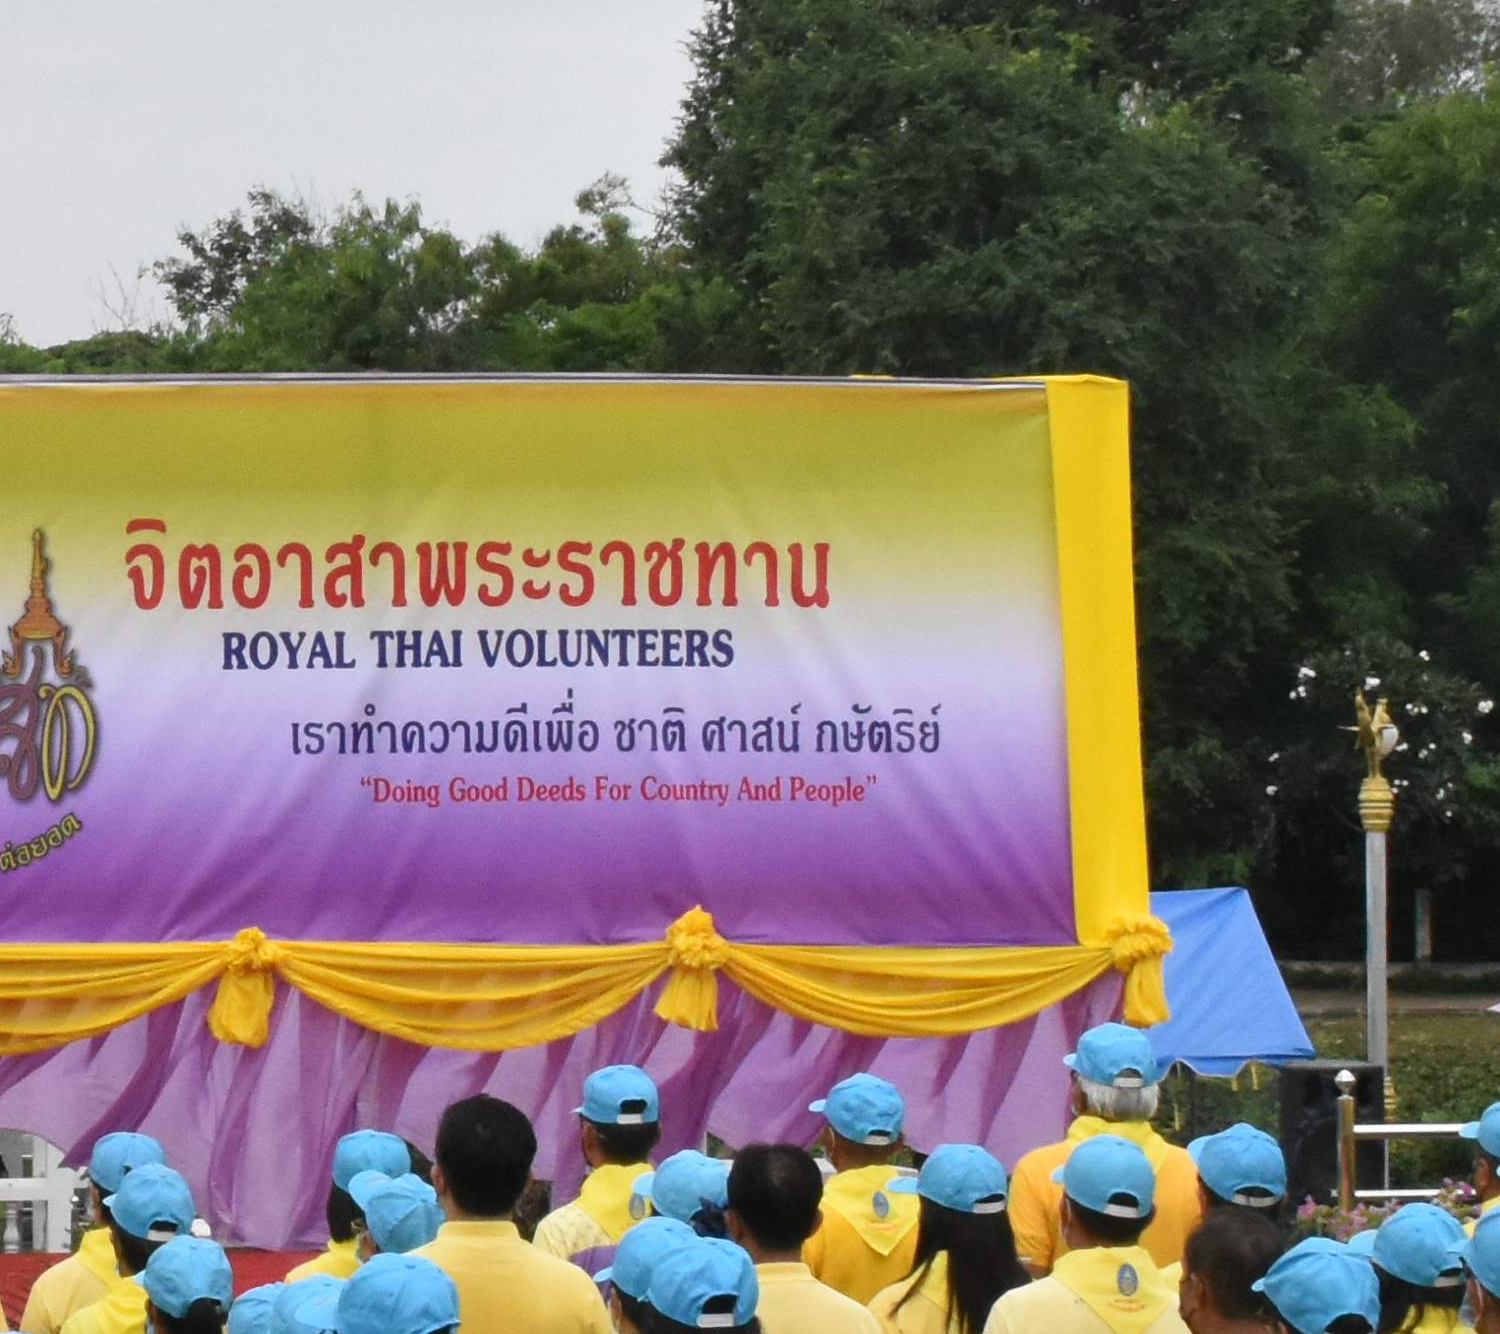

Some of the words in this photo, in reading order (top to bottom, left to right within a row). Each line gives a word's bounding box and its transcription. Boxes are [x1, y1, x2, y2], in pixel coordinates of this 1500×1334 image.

[125, 517, 830, 610] จิตอาสาพระราชทาน
[221, 632, 356, 671] ROYAL
[370, 630, 462, 668] THAI
[478, 629, 734, 668] VOLUNTEERS
[291, 688, 600, 755] เราทำความดีเพื่อ
[614, 707, 687, 753] ชาติ
[701, 702, 802, 753] ศาสน์
[815, 703, 942, 753] กษัตริย์
[450, 776, 509, 802] Good
[517, 776, 587, 802] Deeds
[595, 776, 632, 801] For
[640, 775, 729, 806] Country
[737, 776, 782, 802] And
